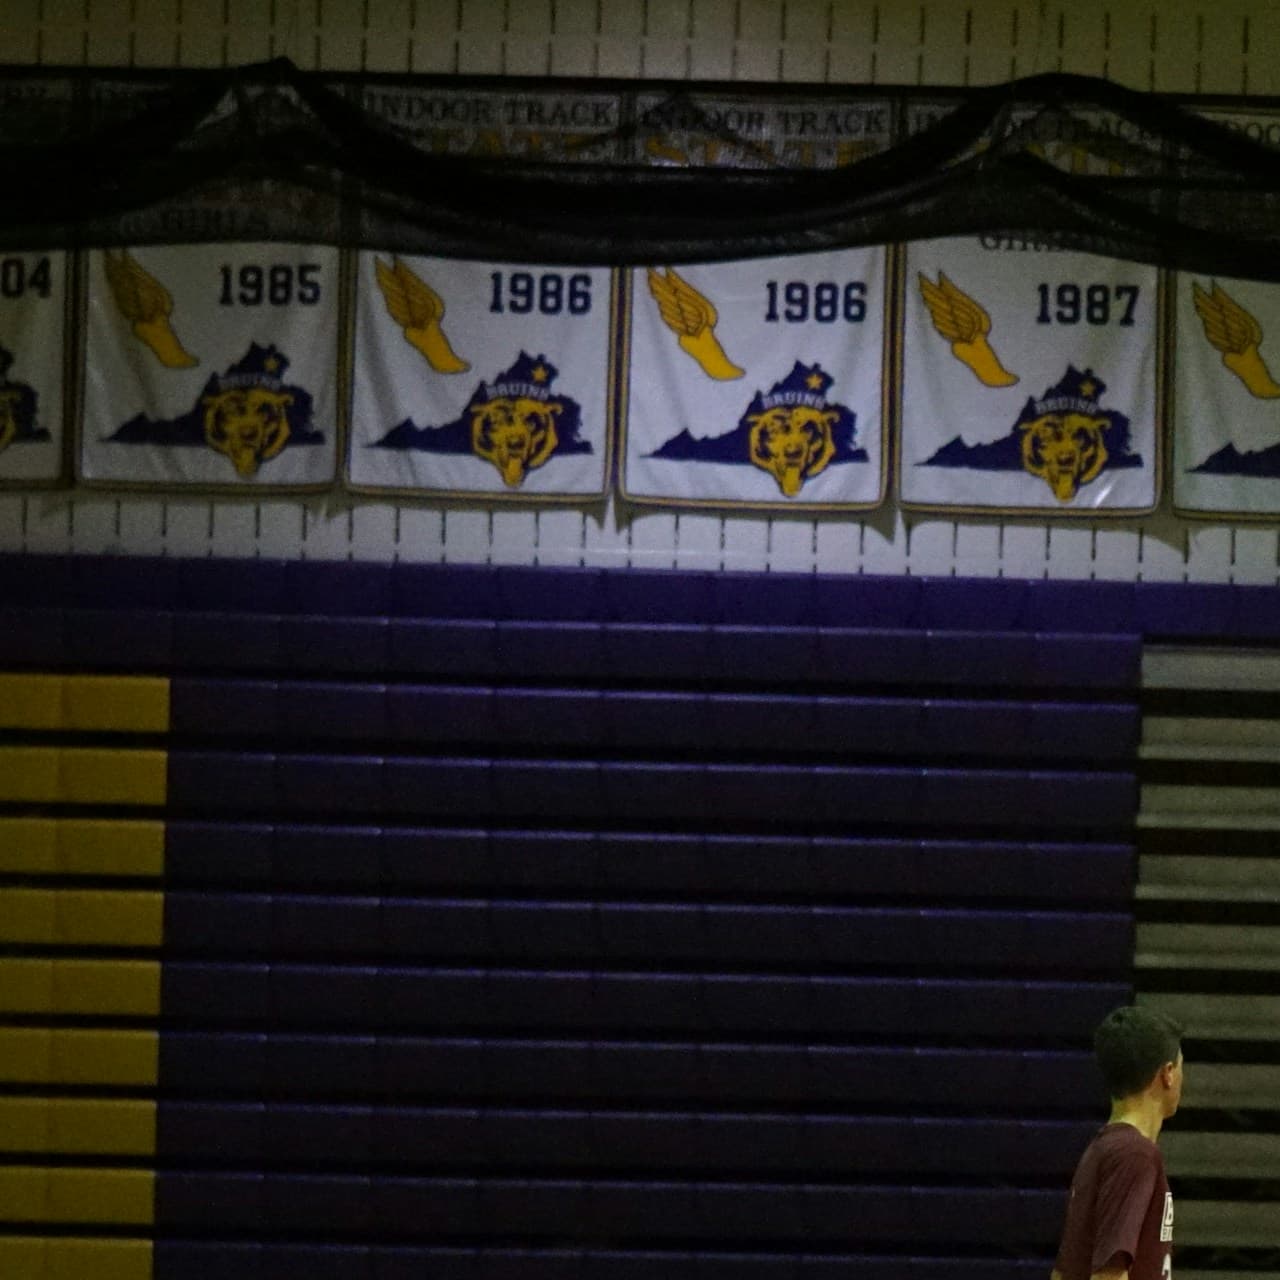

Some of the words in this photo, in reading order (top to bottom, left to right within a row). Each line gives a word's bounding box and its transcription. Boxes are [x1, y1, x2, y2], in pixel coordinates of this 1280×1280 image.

[504, 98, 614, 125] TRACK
[777, 104, 883, 133] TRACK
[218, 264, 321, 305] 1985
[490, 272, 593, 313] 1986
[764, 281, 868, 322] 1986
[1037, 283, 1140, 325] 1987
